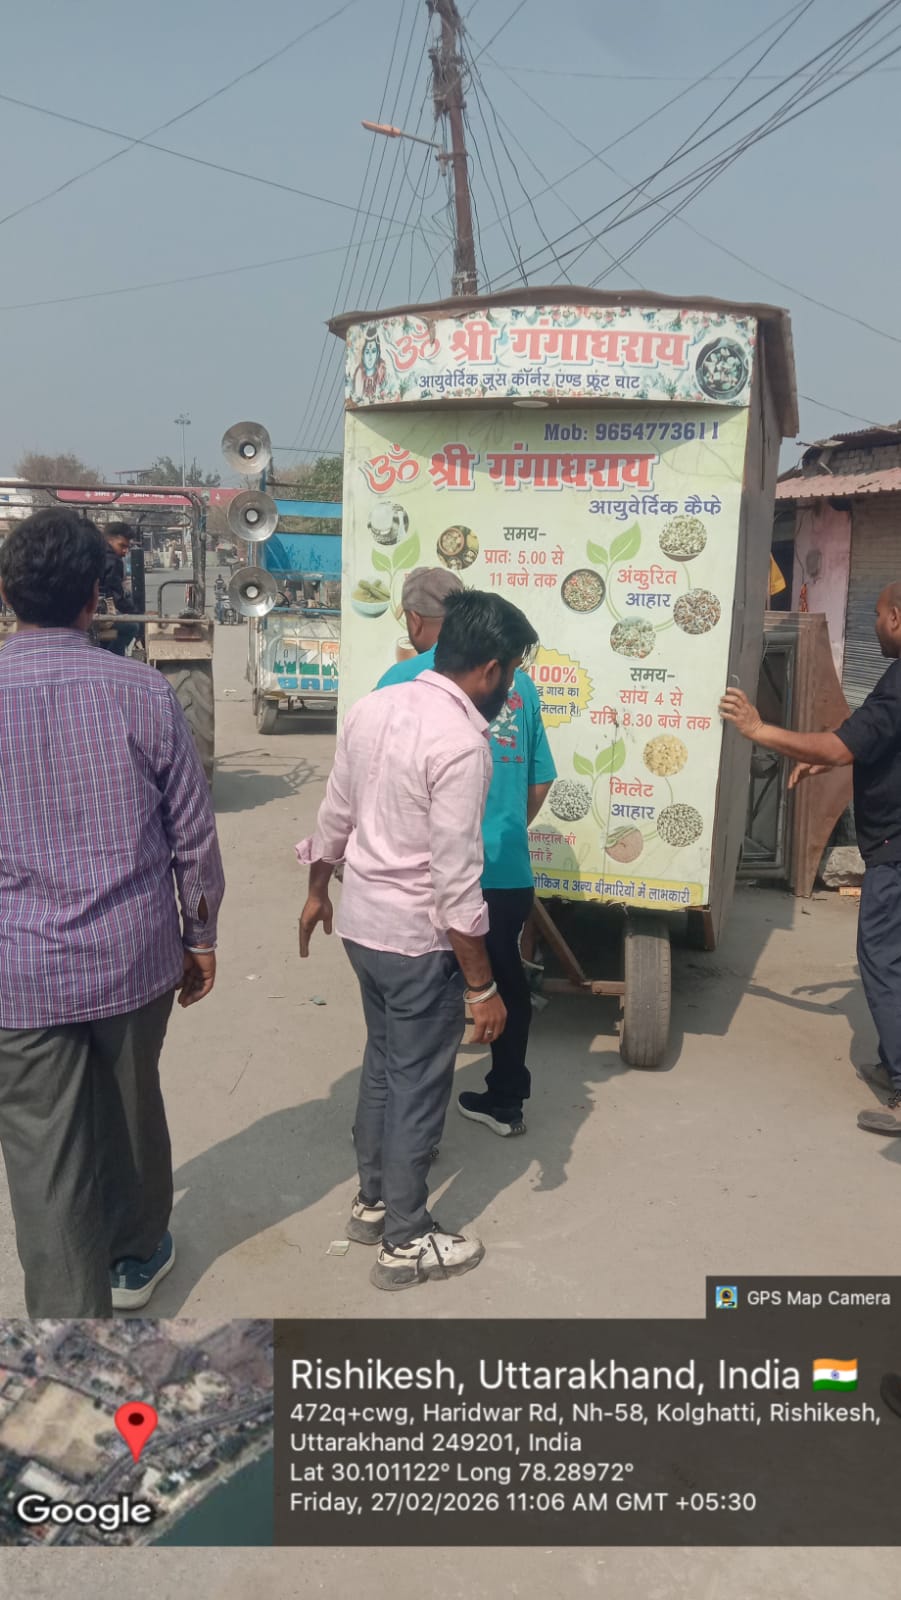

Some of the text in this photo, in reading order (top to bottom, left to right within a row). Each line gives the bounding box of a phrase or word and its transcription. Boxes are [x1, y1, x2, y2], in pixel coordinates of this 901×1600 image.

[449, 321, 497, 362] श्री
[509, 320, 690, 365] गंगाधराय
[615, 375, 640, 389] चाट
[544, 421, 719, 441] Mob: 9654773611
[428, 444, 475, 486] श्री
[487, 443, 656, 487] गंगाधराय
[684, 494, 721, 515] कैफे
[518, 551, 546, 564] 5.00
[551, 544, 564, 565] से
[490, 567, 557, 587] 11 बजे तक
[617, 564, 677, 590] अंकुरित
[625, 593, 671, 609] आहार
[531, 665, 577, 683] 100%
[567, 687, 579, 697] का
[655, 692, 664, 705] 4
[670, 686, 684, 706] से
[622, 713, 652, 727] 8.30
[658, 710, 682, 728] बजे
[686, 715, 712, 730] तक
[609, 776, 654, 797] मिलेट
[611, 804, 655, 820] आहार
[638, 881, 646, 898] में
[649, 887, 690, 903] लाभकारी
